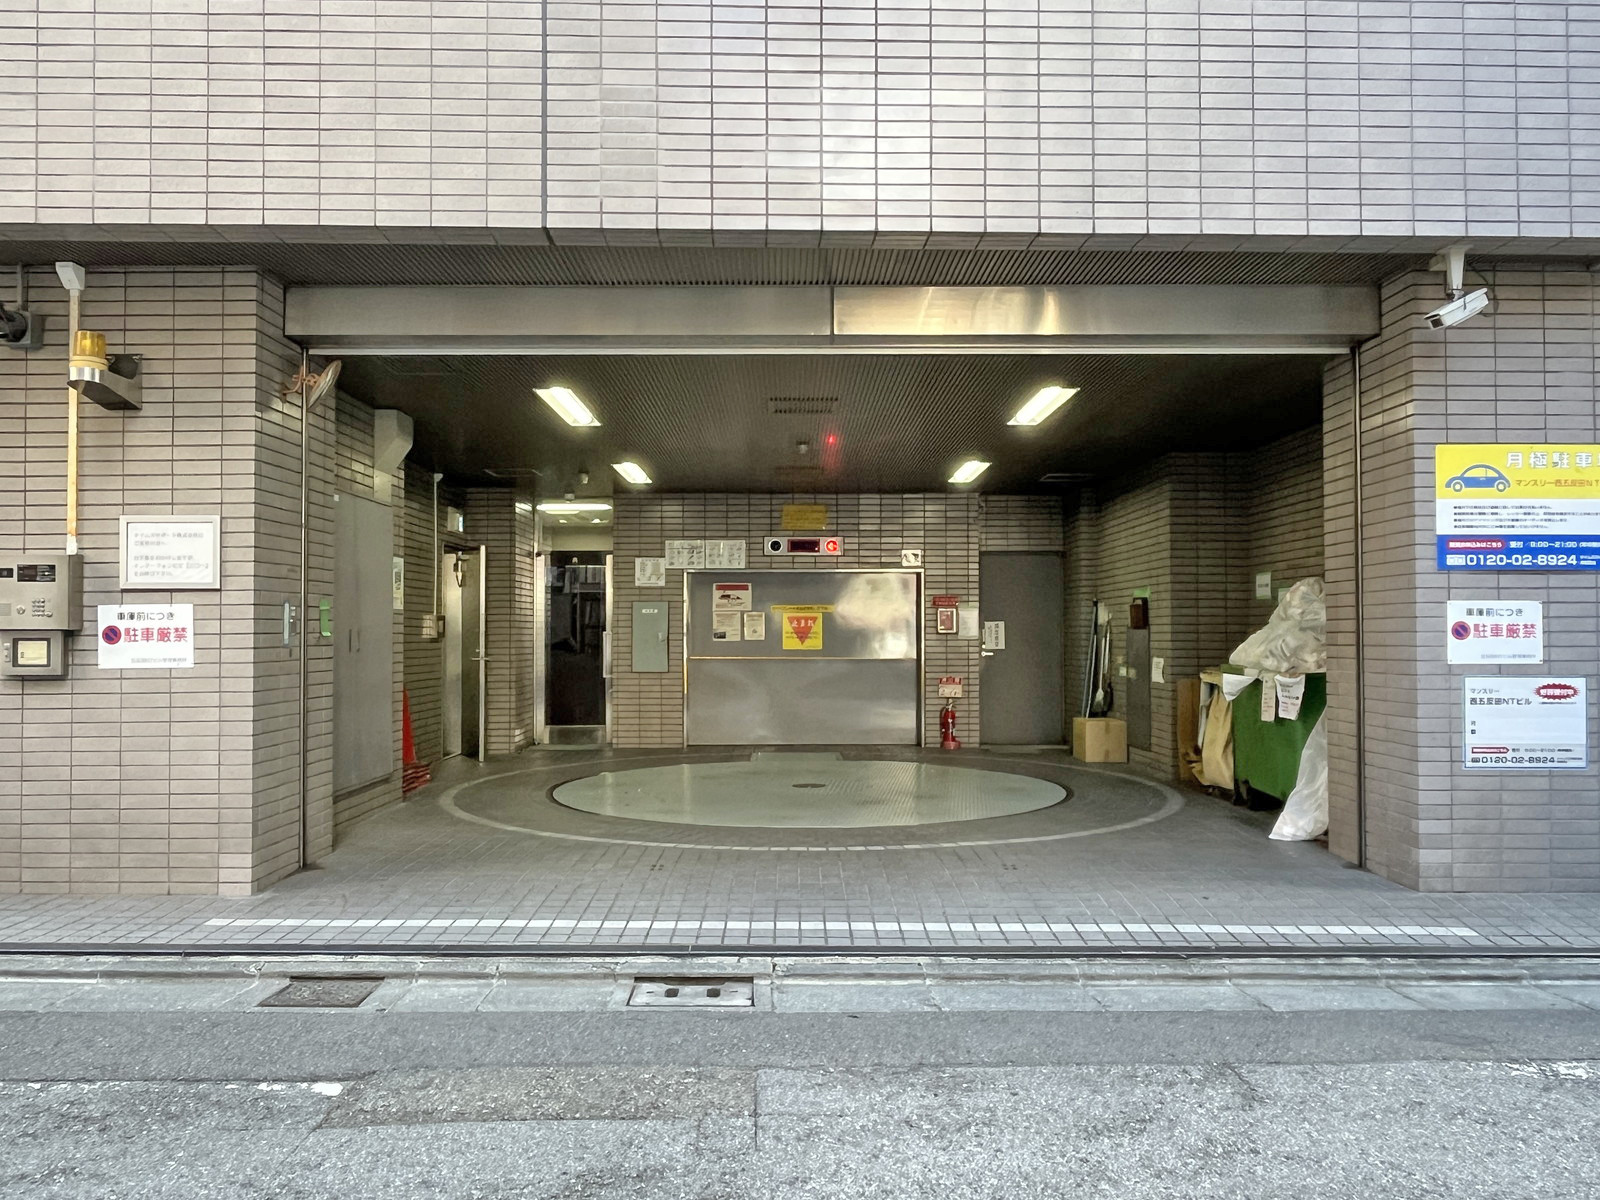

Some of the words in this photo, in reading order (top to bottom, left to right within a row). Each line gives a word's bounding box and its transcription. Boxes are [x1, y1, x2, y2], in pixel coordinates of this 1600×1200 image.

[1506, 452, 1600, 469] 月極駐車
[1466, 554, 1578, 566] 0120-02-8924
[117, 612, 175, 621] 車庫前につき
[1466, 607, 1524, 617] 車庫前につき
[123, 627, 188, 643] 駐車厳禁
[1473, 623, 1537, 639] 駐車厳禁
[1469, 687, 1500, 695] マンスリー
[1469, 697, 1533, 706] 西五反田NTビル
[1481, 756, 1556, 765] 0120-02-8924
